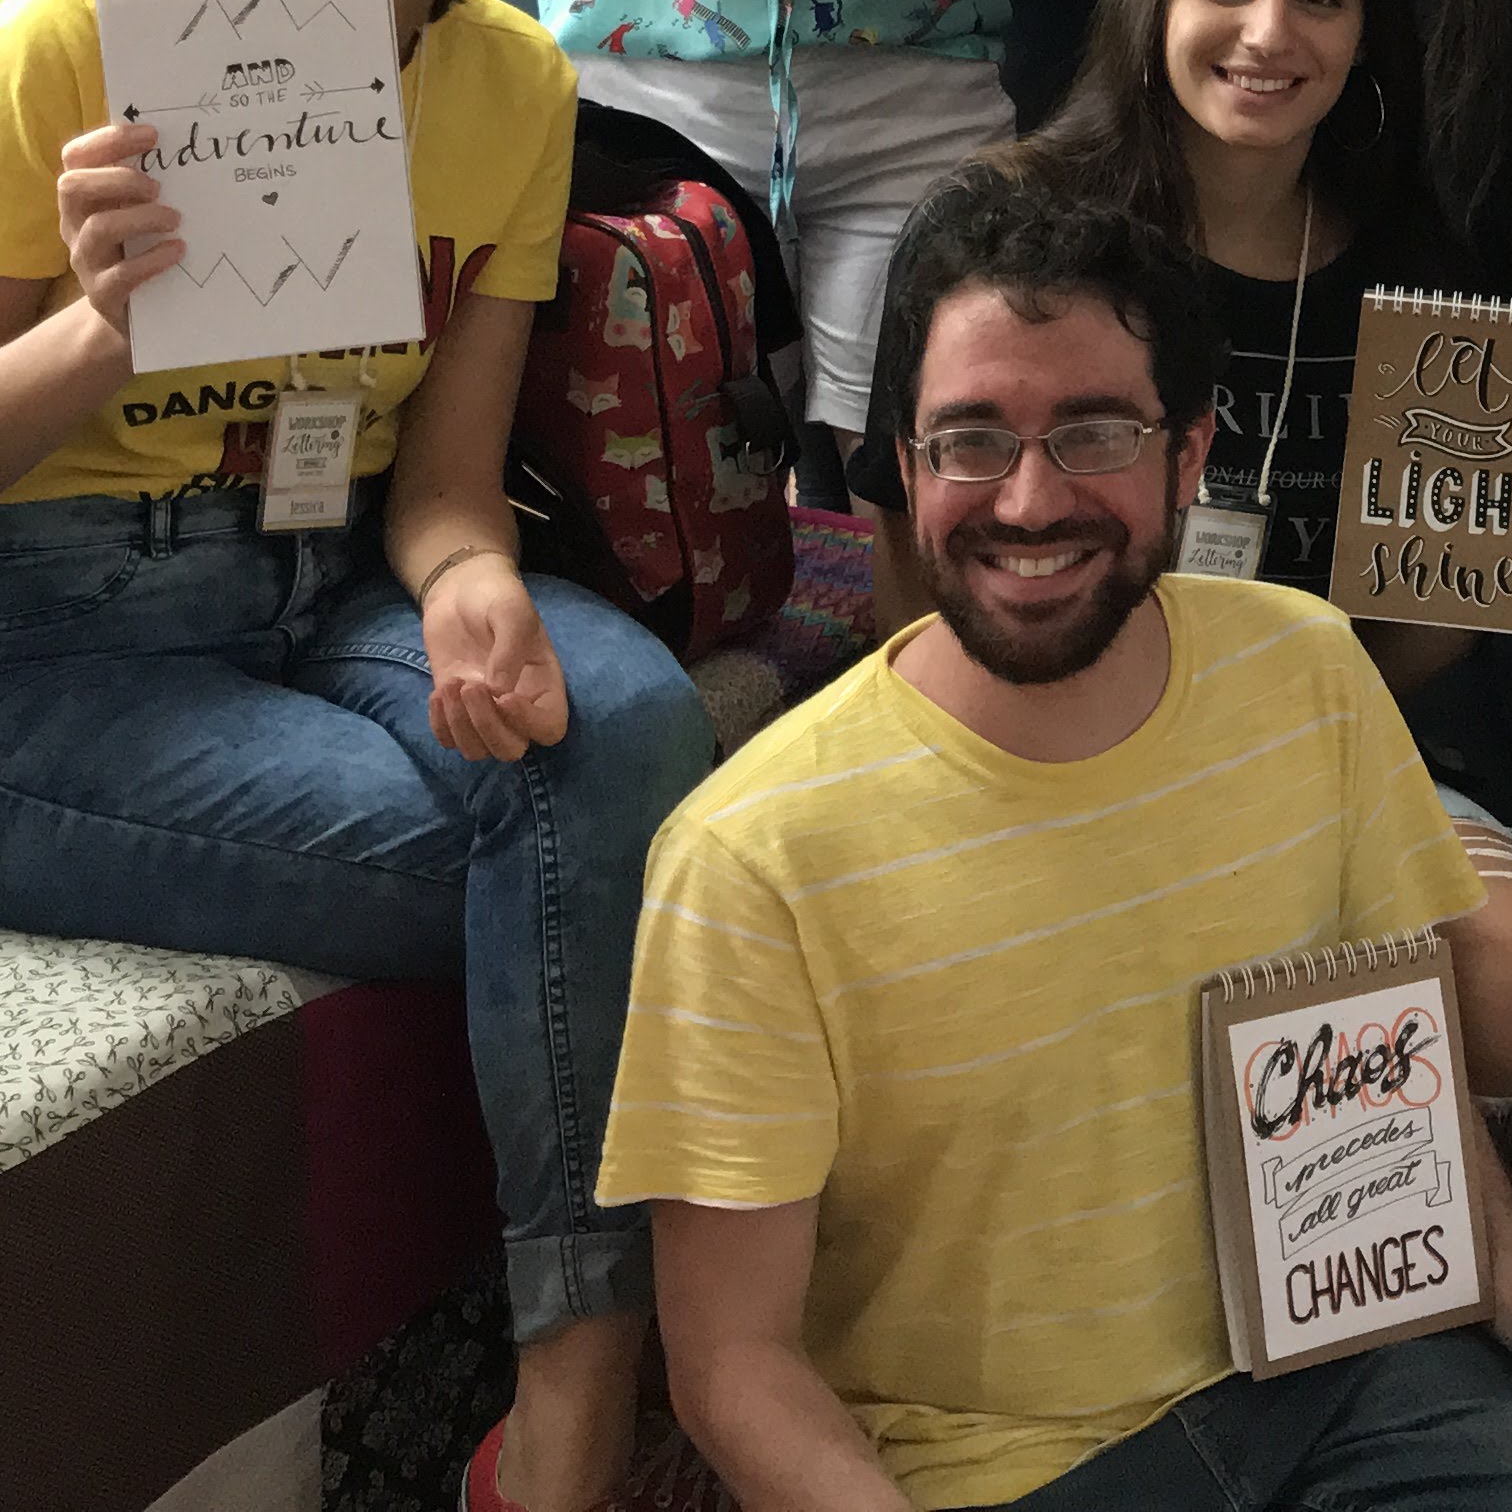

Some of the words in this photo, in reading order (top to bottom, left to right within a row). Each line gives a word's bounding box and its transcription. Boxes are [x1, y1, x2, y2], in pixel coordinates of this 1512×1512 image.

[221, 58, 295, 91] AND
[229, 94, 249, 108] SO
[256, 89, 288, 106] THE
[140, 111, 402, 173] adventure
[234, 164, 298, 182] BEGINS
[122, 379, 327, 428] DANG
[1429, 420, 1485, 452] YOUR
[1284, 1117, 1424, 1194] precedes
[1288, 1194, 1342, 1244] all
[1347, 1158, 1423, 1220] great
[1285, 1223, 1450, 1326] CHANGES
